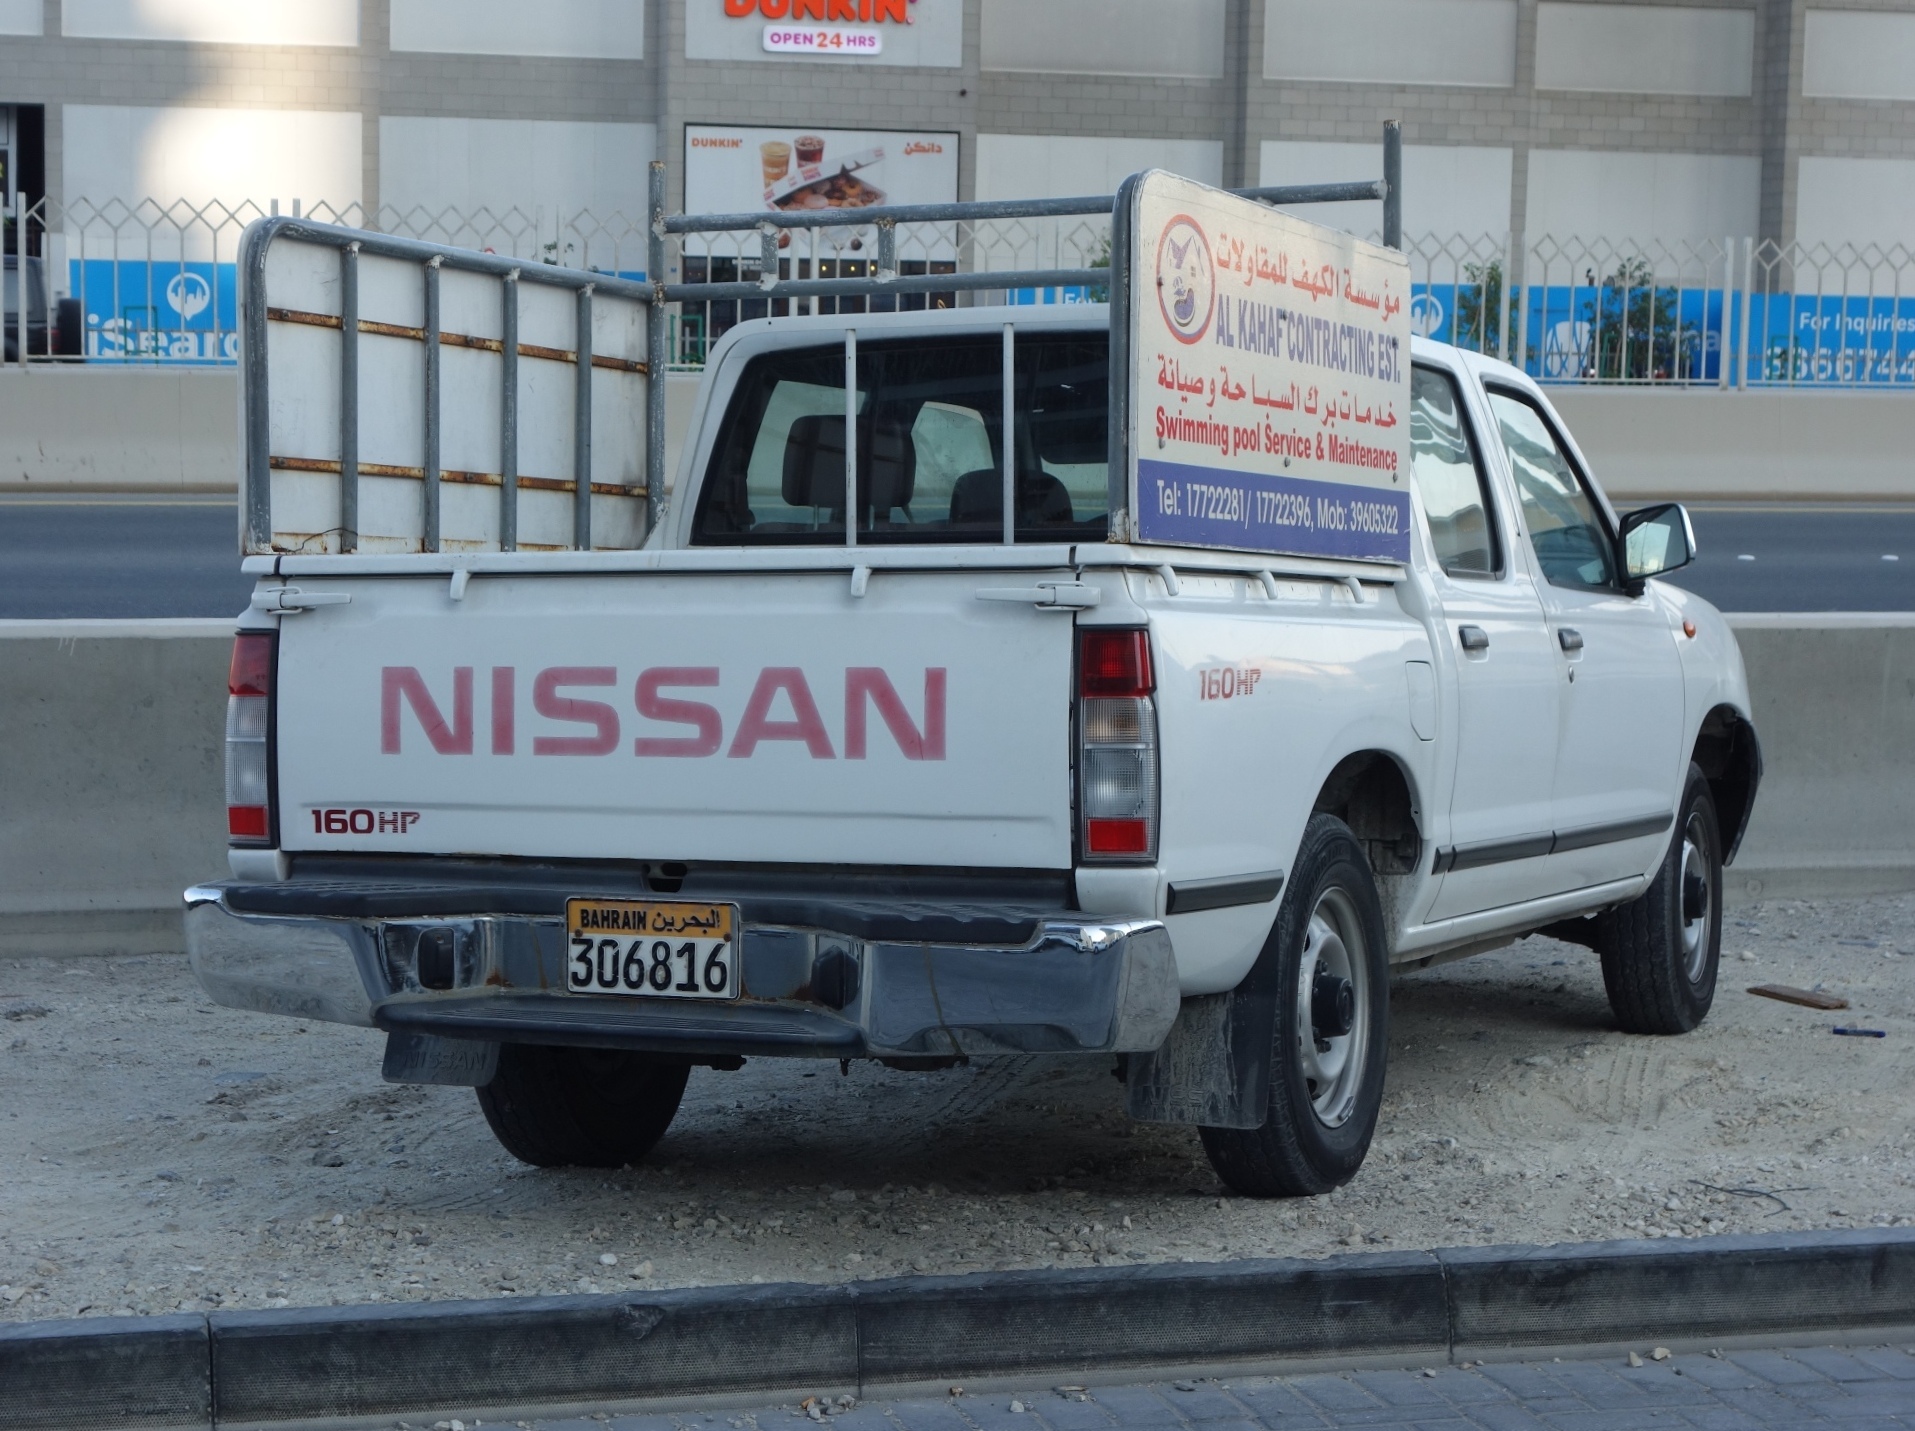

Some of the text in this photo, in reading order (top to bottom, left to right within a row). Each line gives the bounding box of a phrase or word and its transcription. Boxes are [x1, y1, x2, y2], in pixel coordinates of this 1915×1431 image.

[770, 31, 876, 48] OPEN 24 HRS
[691, 137, 743, 149] DUNKIN'
[904, 141, 943, 156] دانكن
[1216, 232, 1400, 323] مؤسسة الكهف للمقاولات
[1216, 293, 1401, 384] AL KAHAF CONTRACTING EST.
[1799, 311, 1832, 331] For
[1220, 365, 1300, 421] السباحة
[1304, 385, 1338, 430] برك
[1339, 390, 1398, 429] خدمات
[1156, 405, 1398, 471] Swimming pool Service & Maintenance
[1156, 480, 1181, 516] Tel:
[1256, 490, 1314, 533] 17722396,
[1317, 497, 1348, 531] Mob:
[1350, 501, 1399, 535] 39605322
[380, 665, 948, 762] NISSAN
[580, 909, 647, 931] BAHRAIN
[652, 908, 720, 935] البحرين
[571, 938, 728, 993] 306816
